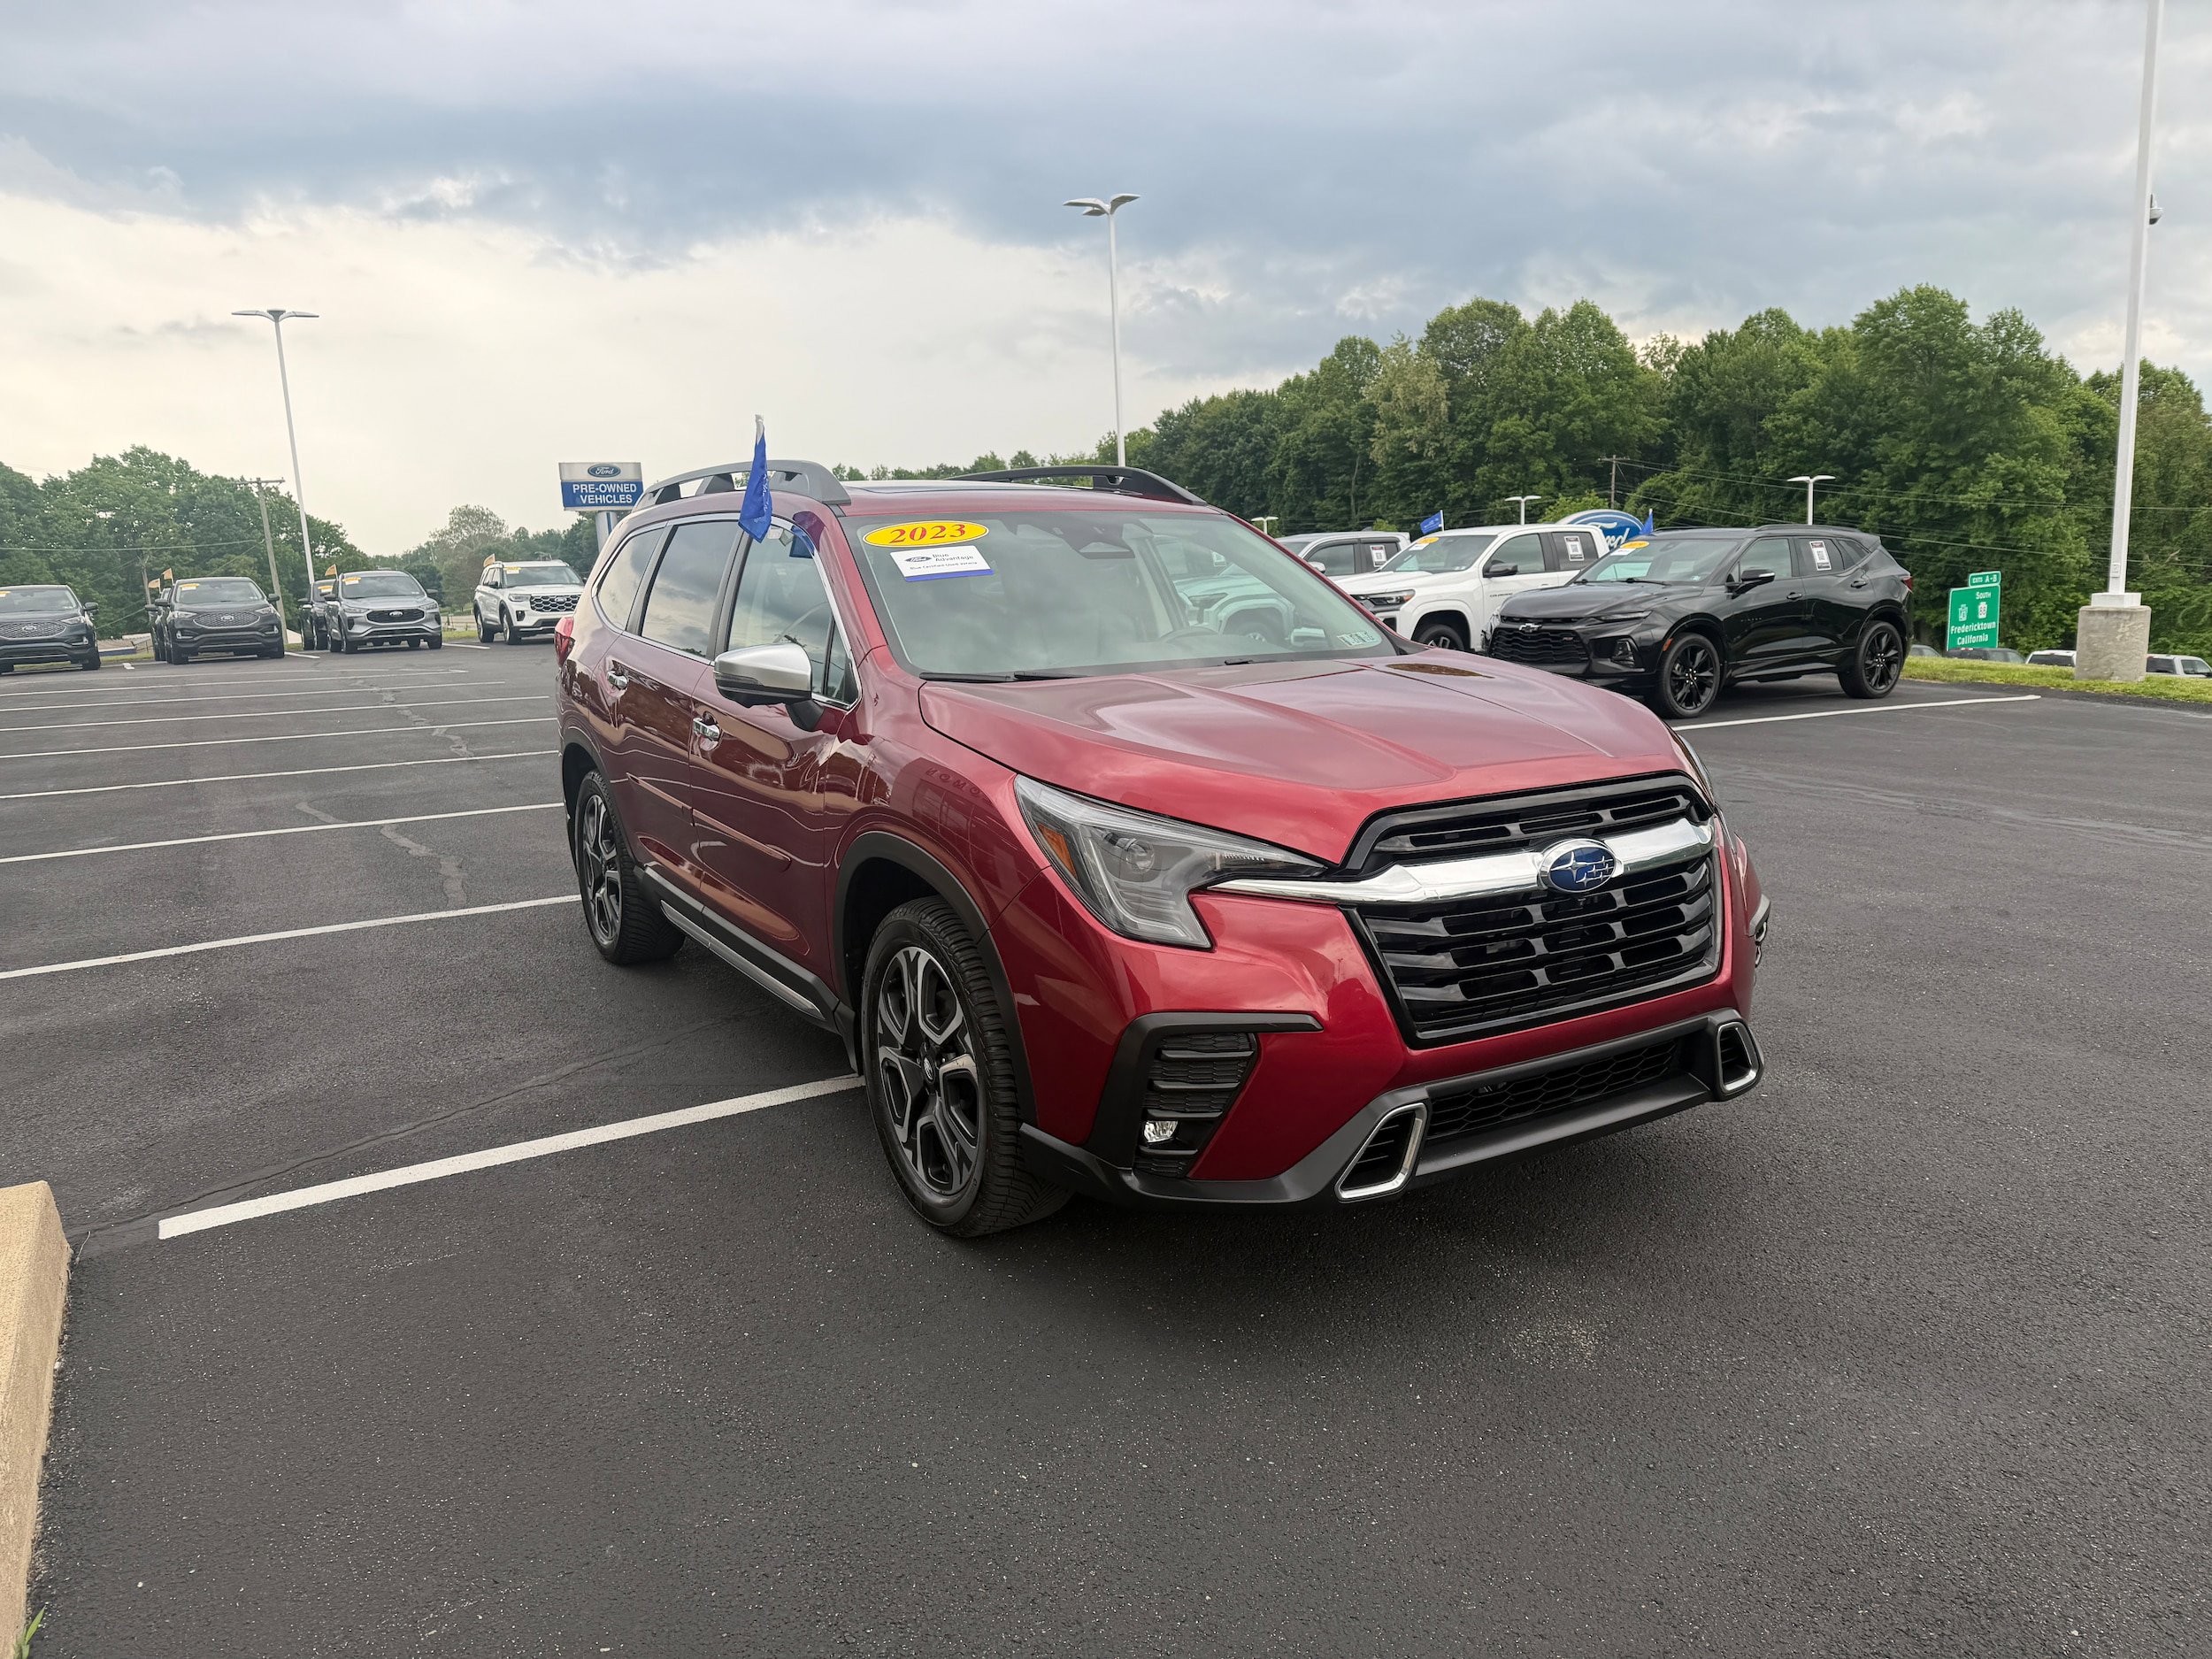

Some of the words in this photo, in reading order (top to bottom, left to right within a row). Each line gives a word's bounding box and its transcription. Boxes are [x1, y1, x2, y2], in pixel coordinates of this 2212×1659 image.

[572, 484, 637, 493] PRE-OWNED
[580, 495, 633, 503] VEHICLES
[888, 524, 965, 544] 2023
[1950, 621, 1996, 634] Fredericktown
[1957, 633, 1988, 645] California
